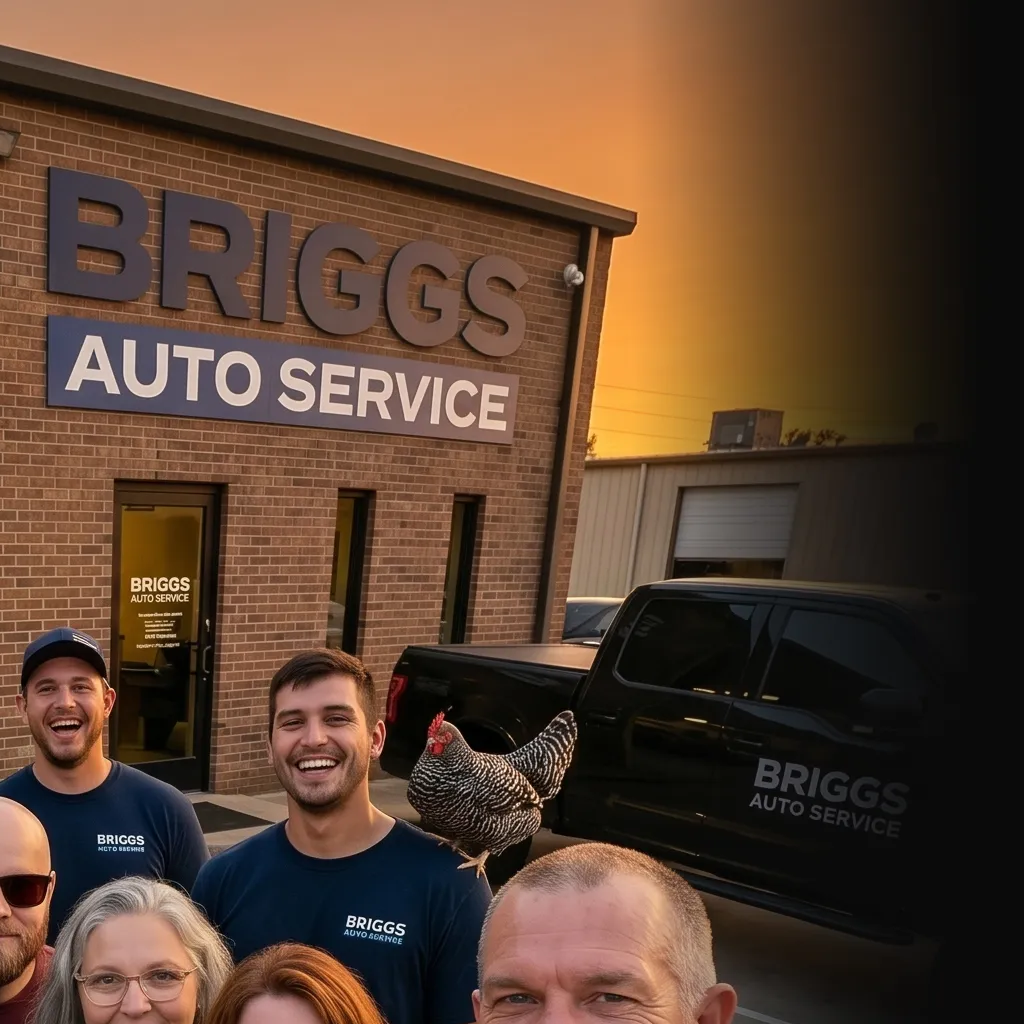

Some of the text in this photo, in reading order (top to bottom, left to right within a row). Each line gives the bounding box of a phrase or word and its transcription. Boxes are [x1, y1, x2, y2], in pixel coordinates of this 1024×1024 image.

[47, 166, 529, 357] BRIGGS
[65, 335, 510, 431] AUTO SERVICE
[130, 577, 190, 592] BRIGGS
[130, 593, 189, 603] AUTO SERVICE
[753, 757, 910, 815] BRIGGS
[749, 792, 902, 838] AUTO SERVICE
[97, 834, 145, 845] BRIGGS
[346, 915, 406, 936] BRIGGS
